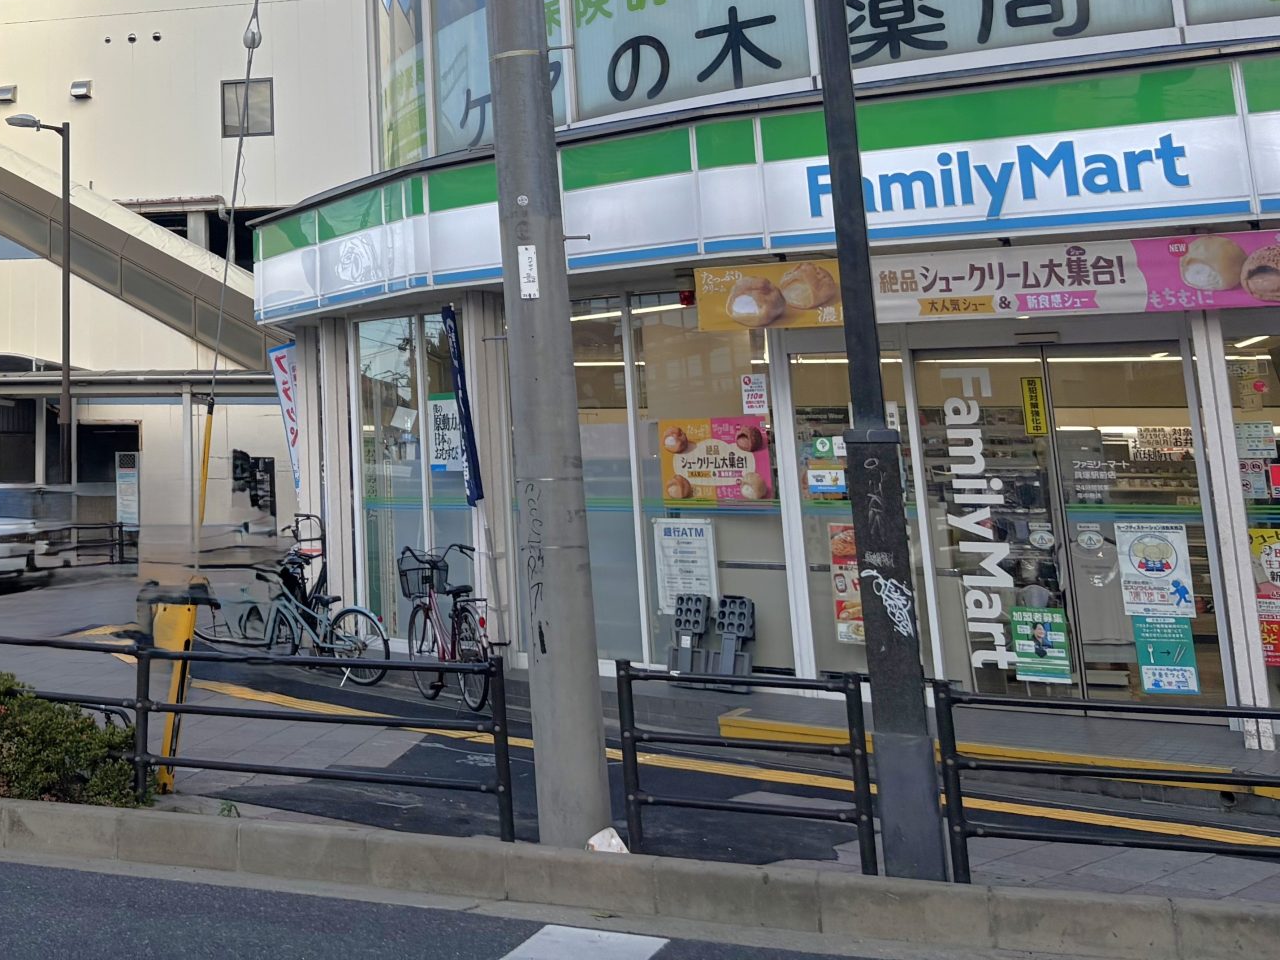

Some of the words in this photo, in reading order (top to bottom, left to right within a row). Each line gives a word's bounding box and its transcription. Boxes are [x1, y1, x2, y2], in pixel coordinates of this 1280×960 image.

[1169, 244, 1186, 252] NEW
[701, 270, 742, 283] たっぷり
[879, 269, 918, 293] 絶品
[919, 255, 1126, 293] シュークリーム大集合!
[928, 298, 986, 313] 大人気シュー
[999, 296, 1011, 310] &
[1026, 294, 1089, 310] 新食感シュー
[817, 306, 844, 323] 濃
[681, 456, 748, 469] シュークリーム大集合!
[1072, 460, 1130, 469] ファミリーマート
[940, 367, 1020, 669] FamilyMart
[663, 527, 704, 538] 銀行ATM
